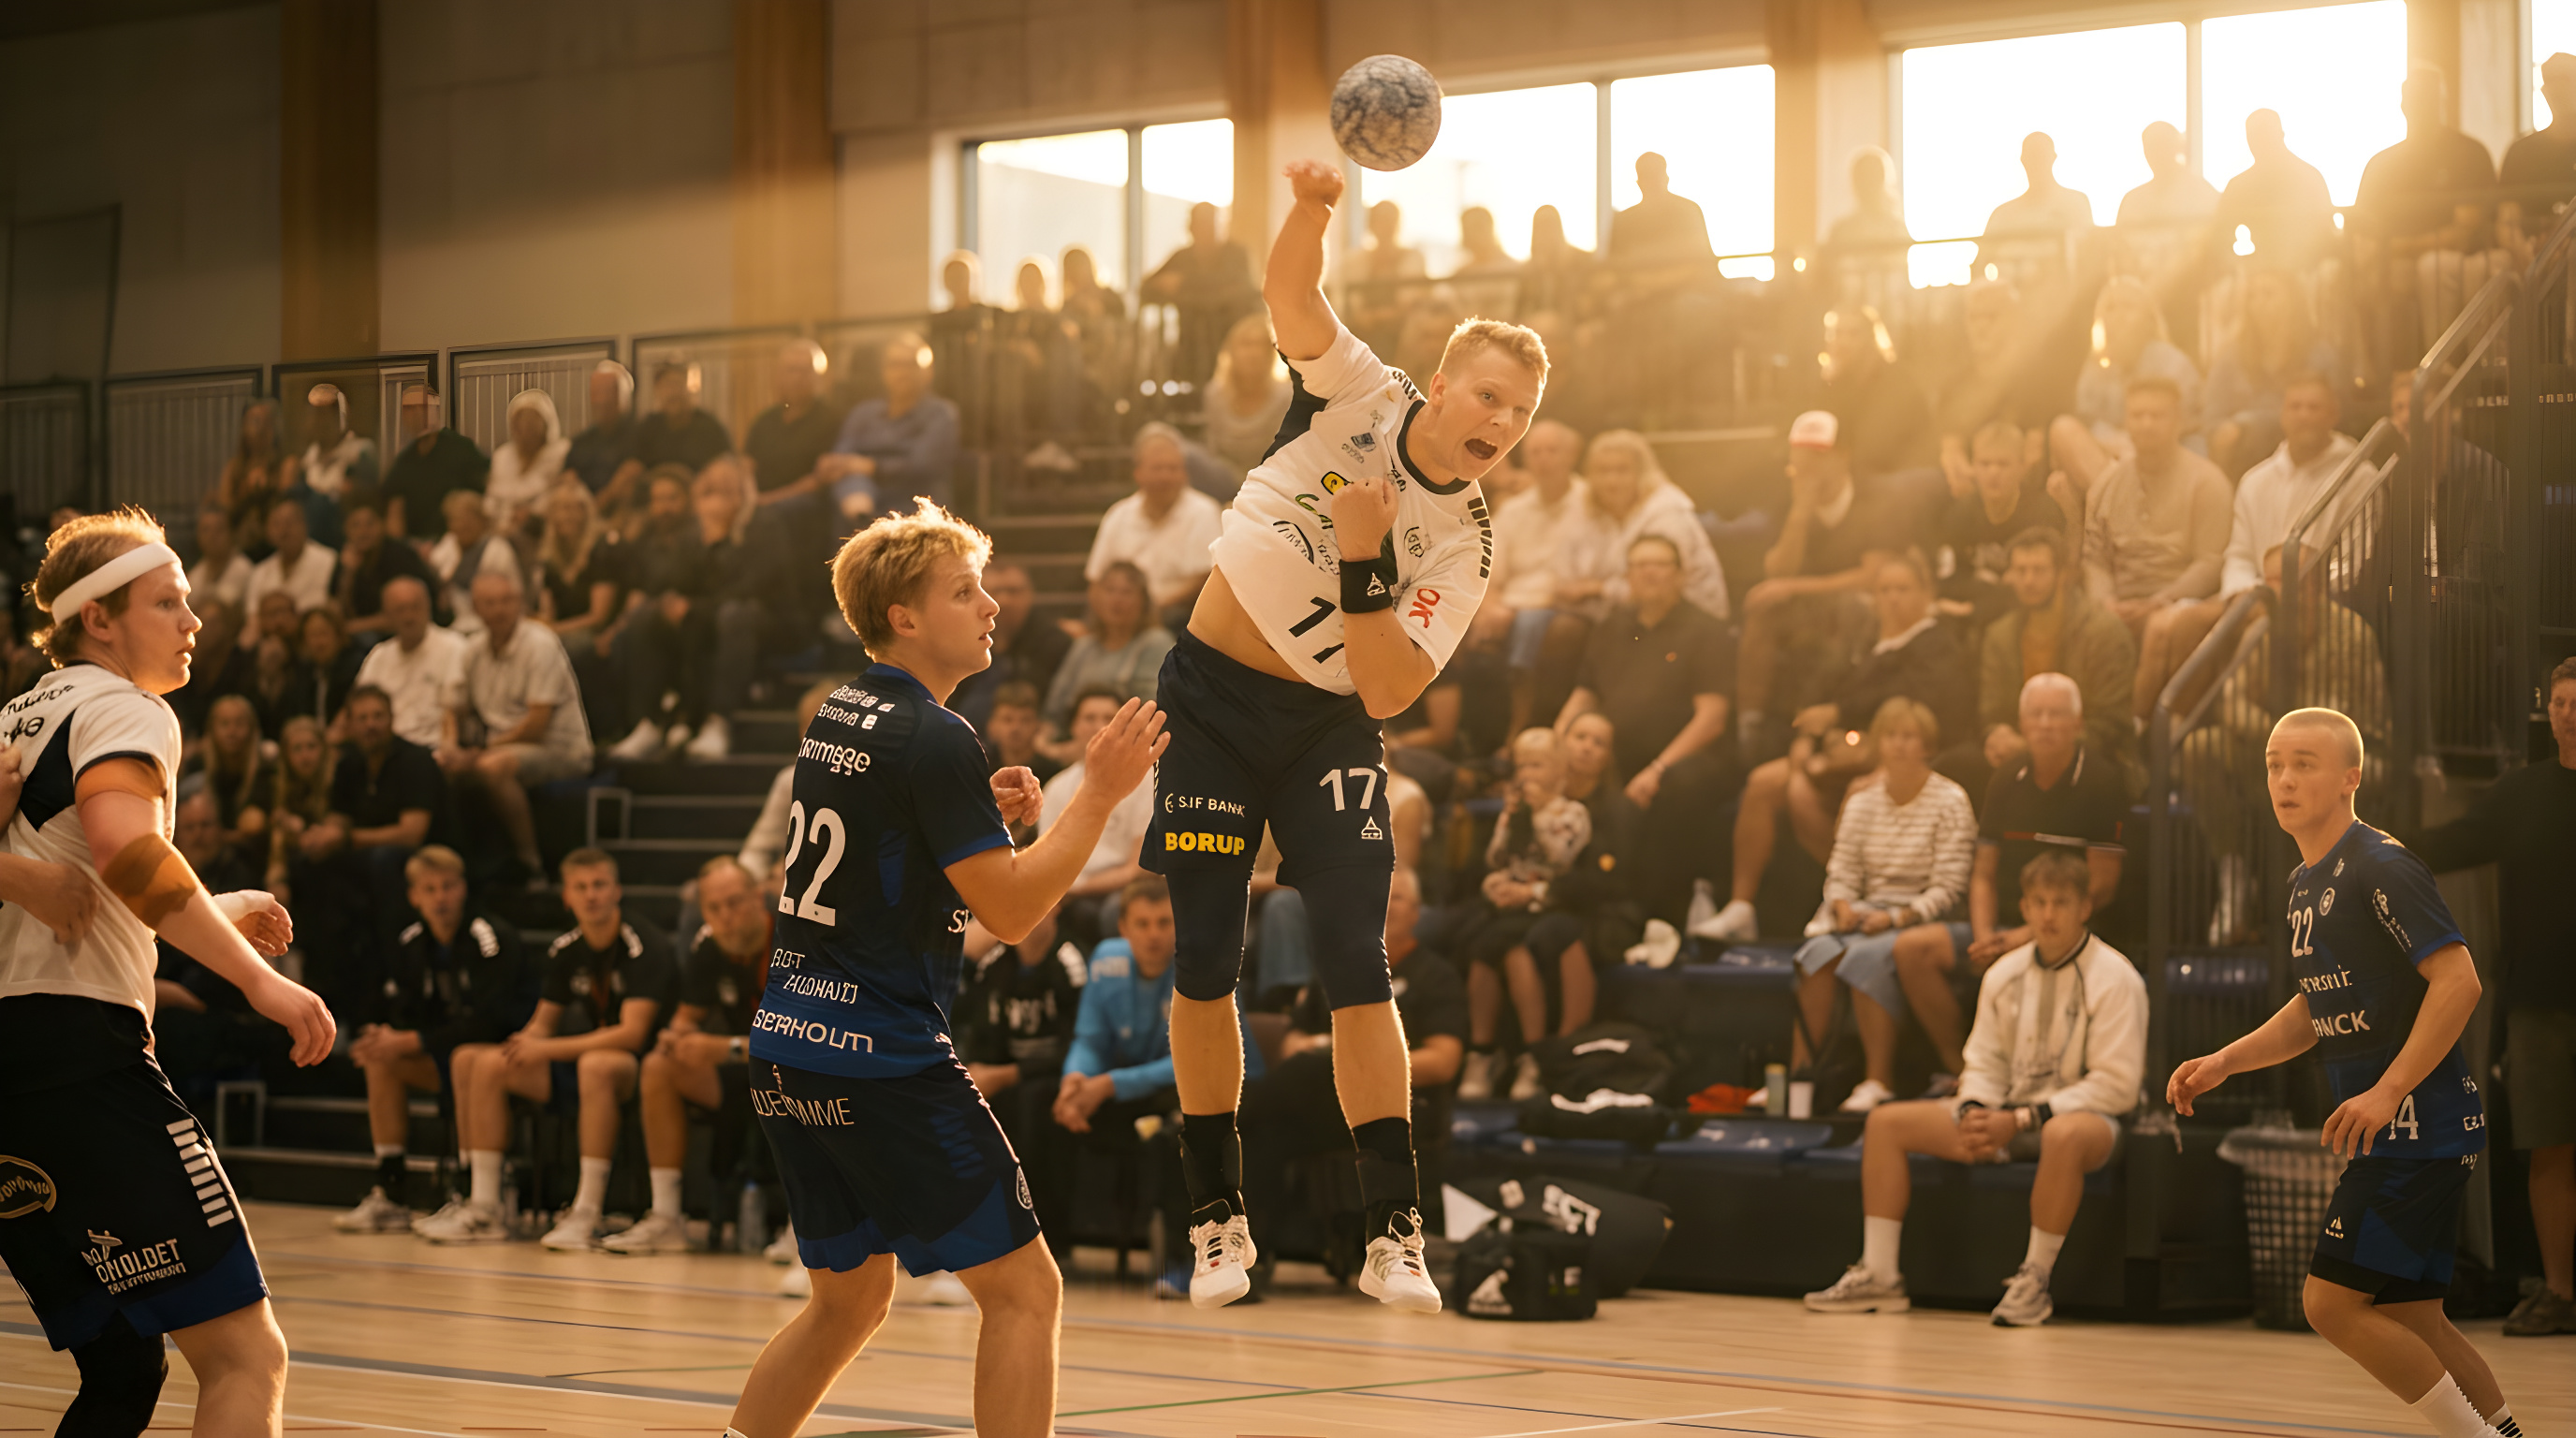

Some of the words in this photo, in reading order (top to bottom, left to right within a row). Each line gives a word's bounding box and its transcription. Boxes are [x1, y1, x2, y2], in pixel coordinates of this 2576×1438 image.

[1408, 588, 1441, 628] OK
[1319, 768, 1378, 811] 17
[778, 800, 846, 927] 22
[1164, 831, 1245, 856] BORUP
[2291, 906, 2314, 958] 22
